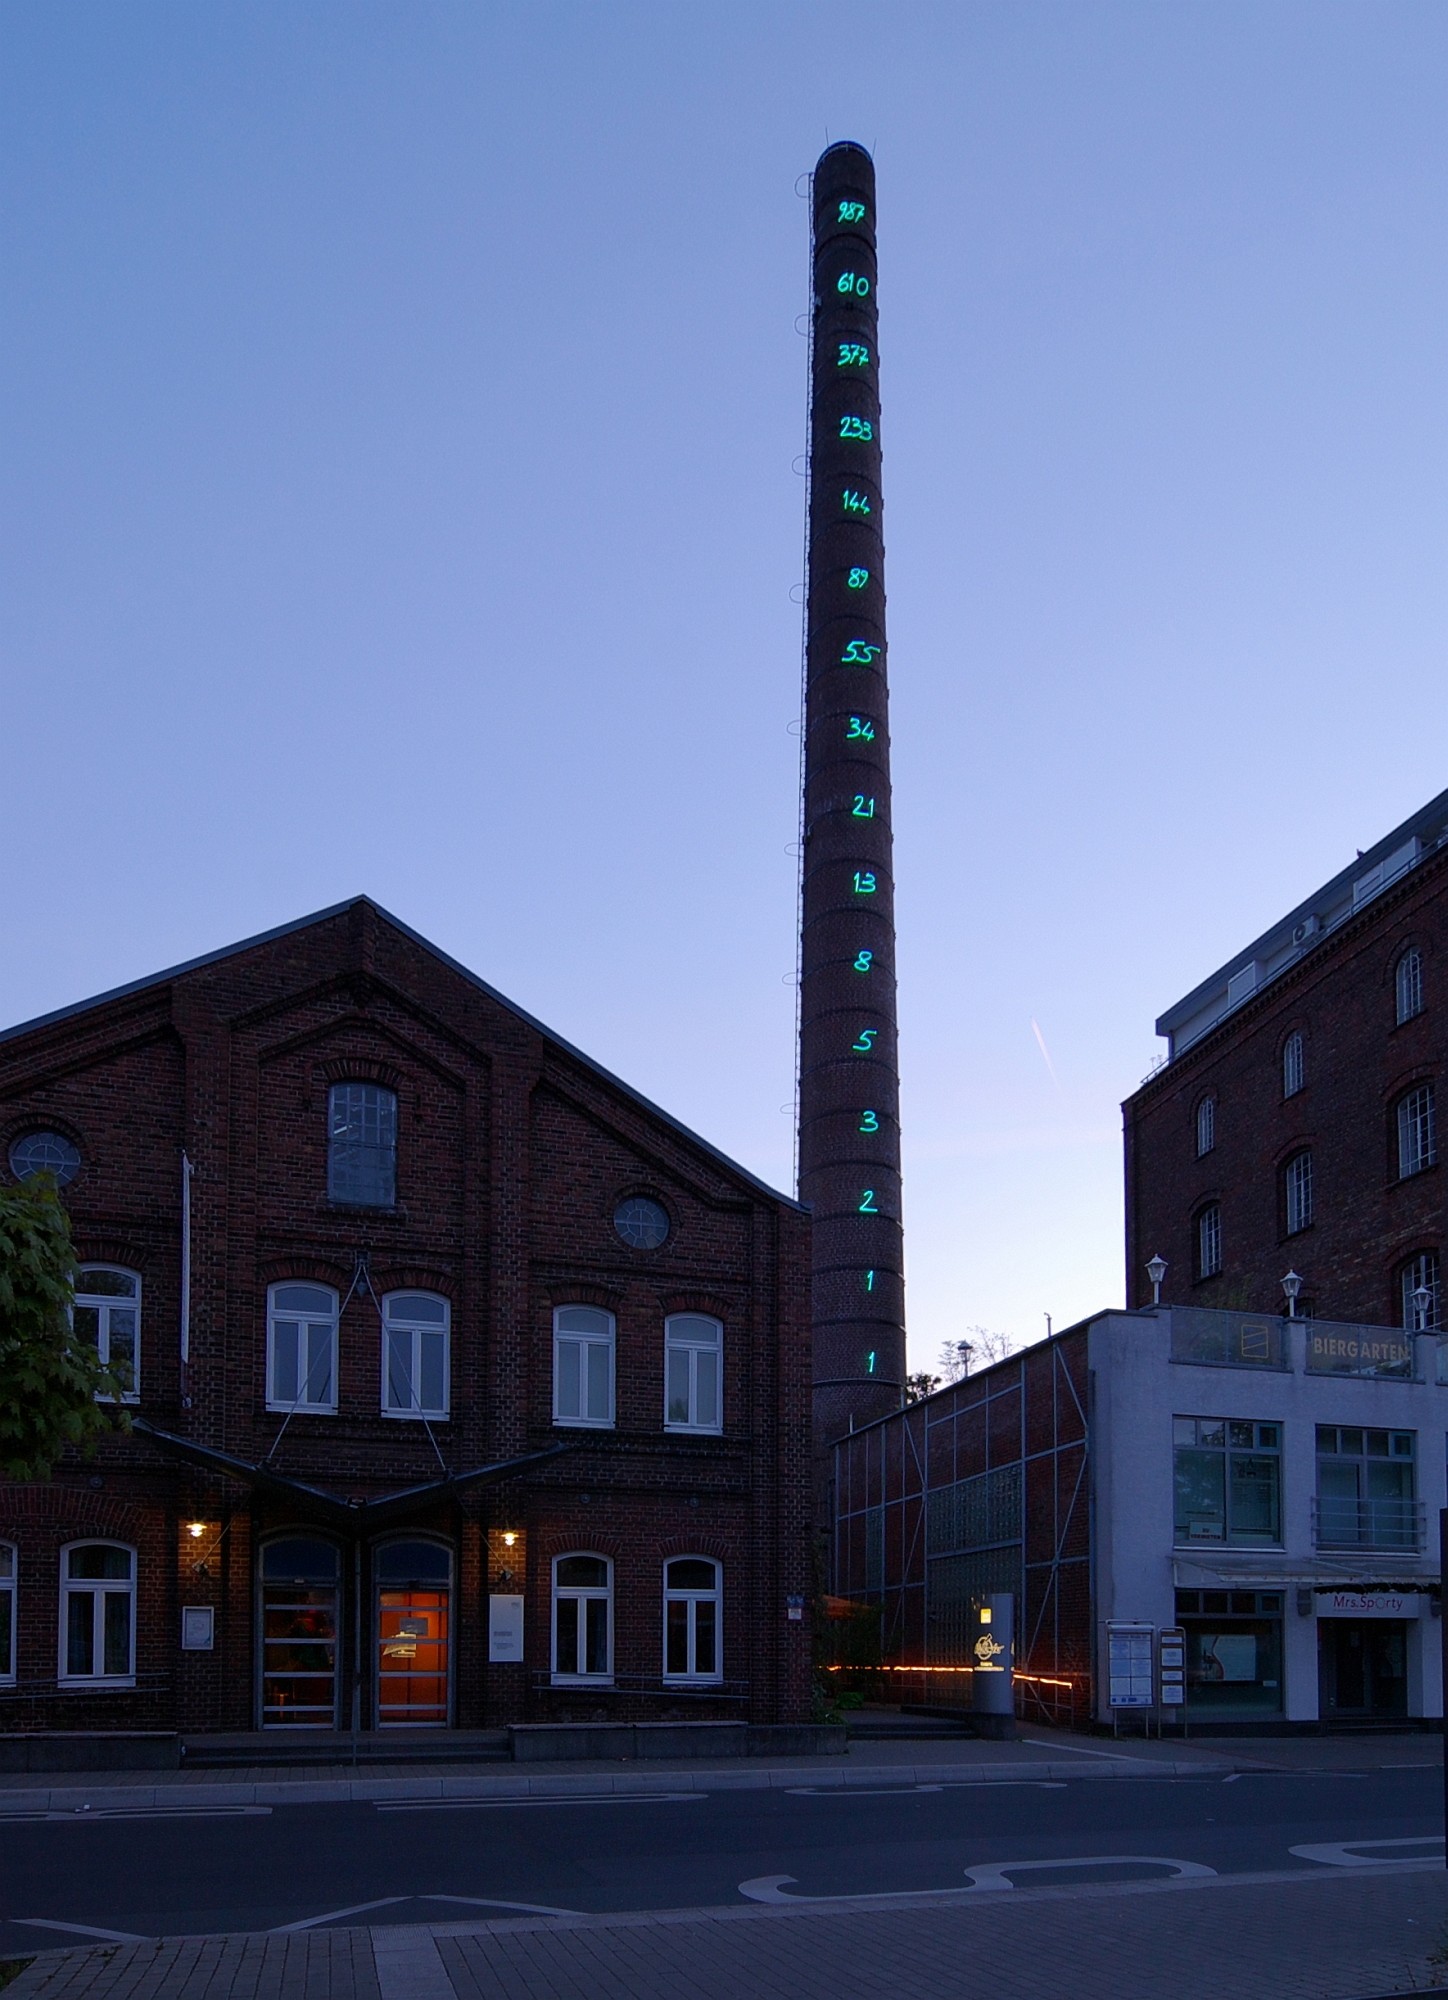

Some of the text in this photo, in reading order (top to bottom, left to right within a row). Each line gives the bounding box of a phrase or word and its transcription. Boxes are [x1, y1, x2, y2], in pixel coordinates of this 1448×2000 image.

[837, 201, 866, 223] 987
[837, 273, 870, 297] 610
[837, 344, 870, 367] 377
[839, 416, 873, 441] 233
[842, 490, 872, 515] 144
[847, 568, 870, 589] 89
[841, 640, 881, 664] 55
[846, 718, 875, 742] 34
[851, 795, 874, 819] 21
[853, 872, 876, 894] 13
[853, 951, 872, 972] 8
[852, 1030, 878, 1052] 5
[859, 1110, 878, 1133] 3
[858, 1190, 878, 1213] 2
[866, 1271, 874, 1292] 1
[1313, 1337, 1410, 1360] BIERGARTEN
[867, 1352, 875, 1373] 1
